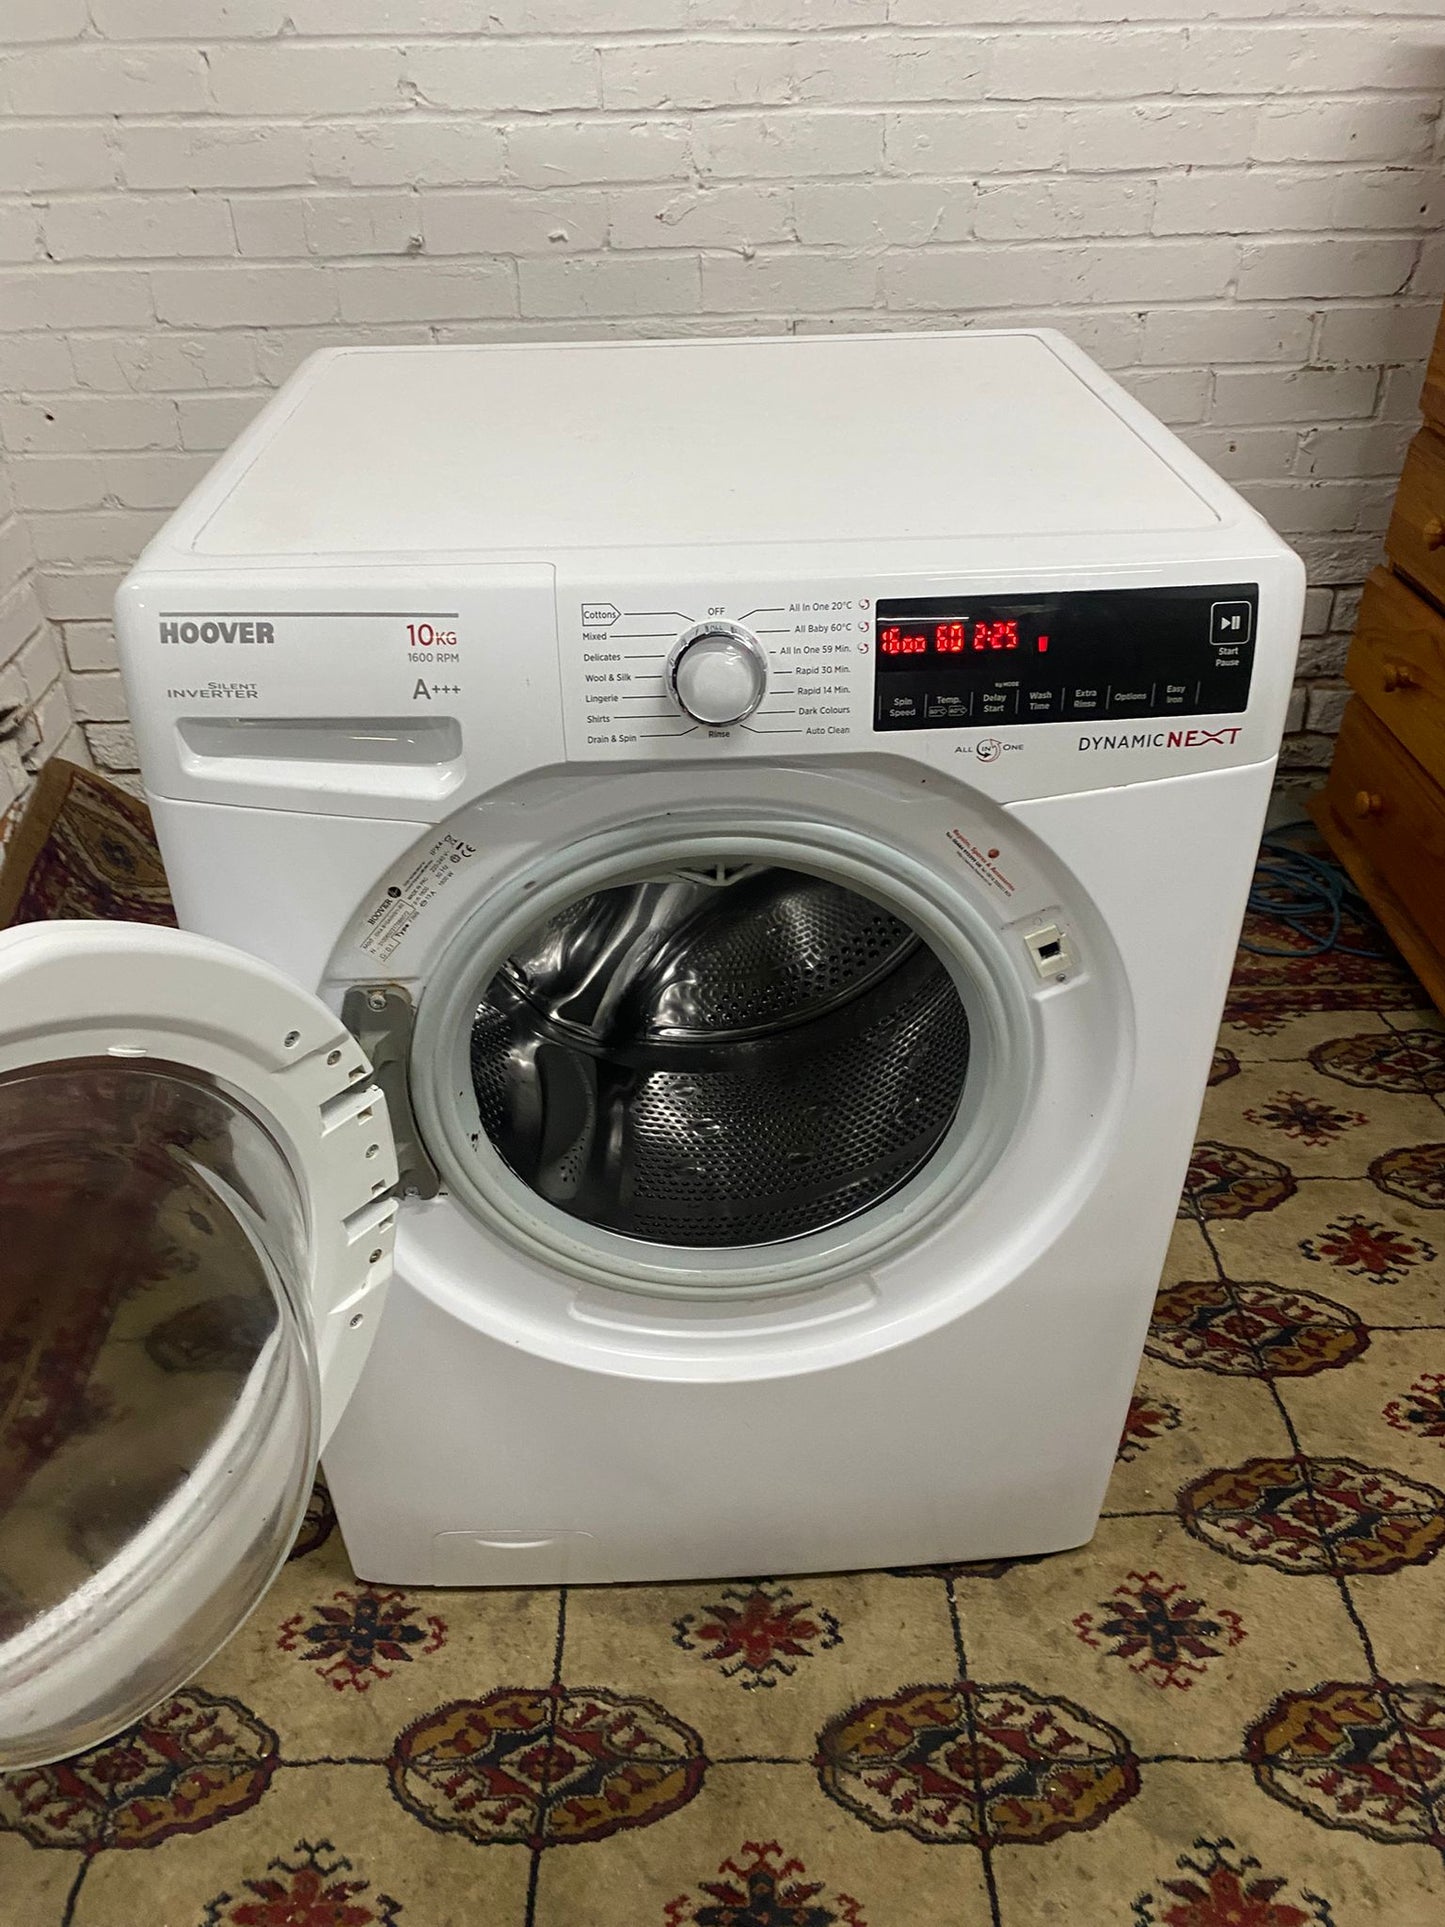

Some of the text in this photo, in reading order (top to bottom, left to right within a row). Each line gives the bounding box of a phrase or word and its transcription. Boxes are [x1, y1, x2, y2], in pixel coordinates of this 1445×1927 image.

[789, 604, 801, 612] All
[814, 602, 829, 610] One
[832, 601, 852, 610] 20°C
[584, 610, 617, 619] Cottons
[708, 608, 725, 616] OFF
[160, 622, 274, 644] HOOVER
[795, 623, 852, 634] All Baby 60°C
[407, 624, 457, 646] 10KG
[583, 632, 607, 640] Mixed
[936, 623, 964, 652] 60
[973, 620, 1018, 650] 2:25
[780, 647, 791, 655] All
[794, 646, 801, 654] In
[804, 646, 820, 654] One
[822, 645, 833, 653] 59
[1218, 647, 1239, 656] Start
[407, 653, 459, 663] 1600 RPM
[584, 653, 621, 661] Delicates
[1216, 658, 1240, 668] Pause
[796, 666, 851, 676] Rapid 30 Min.
[586, 673, 632, 682] Wool & Silk
[167, 690, 258, 698] INVERTER
[413, 679, 461, 700] A+++
[798, 686, 851, 696] Rapid 14 Min.
[1075, 689, 1097, 697] Extra
[1167, 685, 1186, 694] Easy
[586, 694, 619, 703] Lingerie
[983, 694, 1007, 703] Delay
[1030, 691, 1052, 700] Wash
[1114, 692, 1147, 701] Options
[894, 698, 913, 706] Spin
[937, 696, 961, 705] Temp.
[1074, 700, 1097, 708] Rinse
[799, 706, 850, 715] Dark Colours
[984, 704, 1004, 712] Start
[1030, 702, 1050, 710] Time
[890, 708, 916, 718] Speed
[587, 715, 610, 723] Shirts
[708, 730, 730, 738] Rinse
[806, 726, 850, 736] Auto Clean
[587, 734, 637, 744] Drain & Spin
[367, 898, 393, 925] HOOVER
